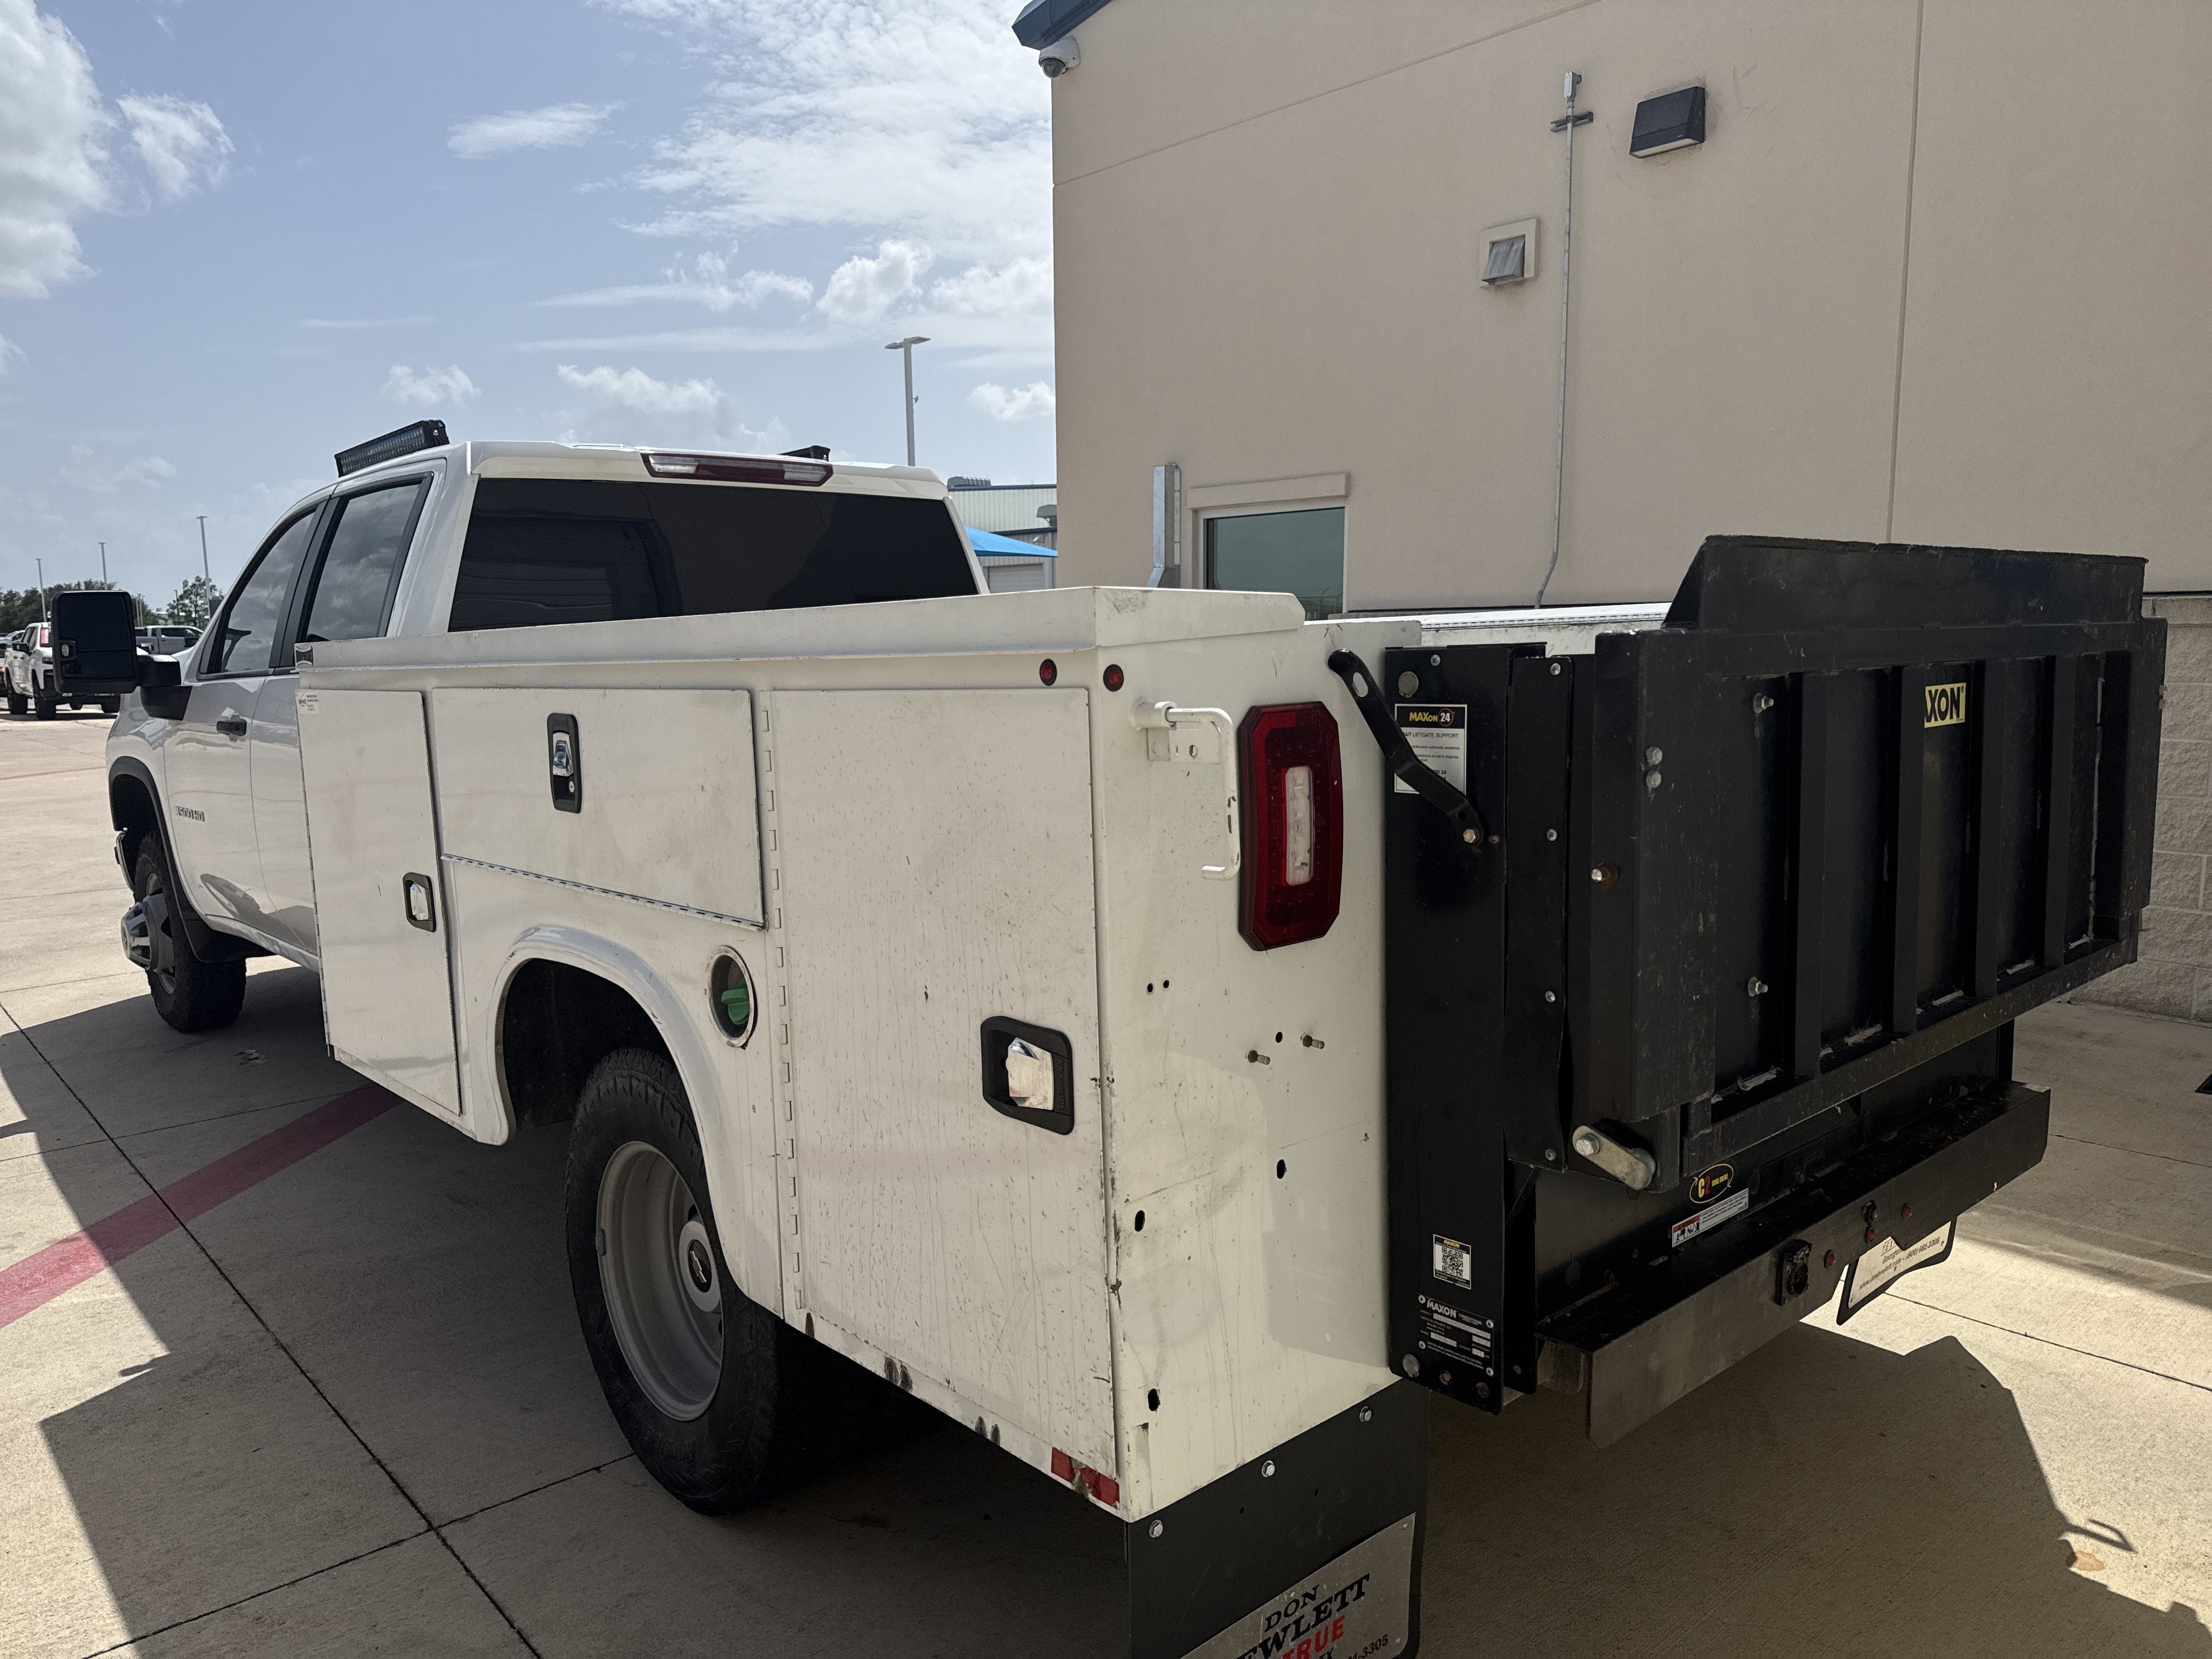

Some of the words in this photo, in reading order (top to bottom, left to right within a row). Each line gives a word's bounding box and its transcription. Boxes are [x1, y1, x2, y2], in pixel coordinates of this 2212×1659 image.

[1440, 713, 1451, 722] 24
[1427, 1298, 1457, 1318] MAXON
[1265, 1584, 1319, 1633] DON
